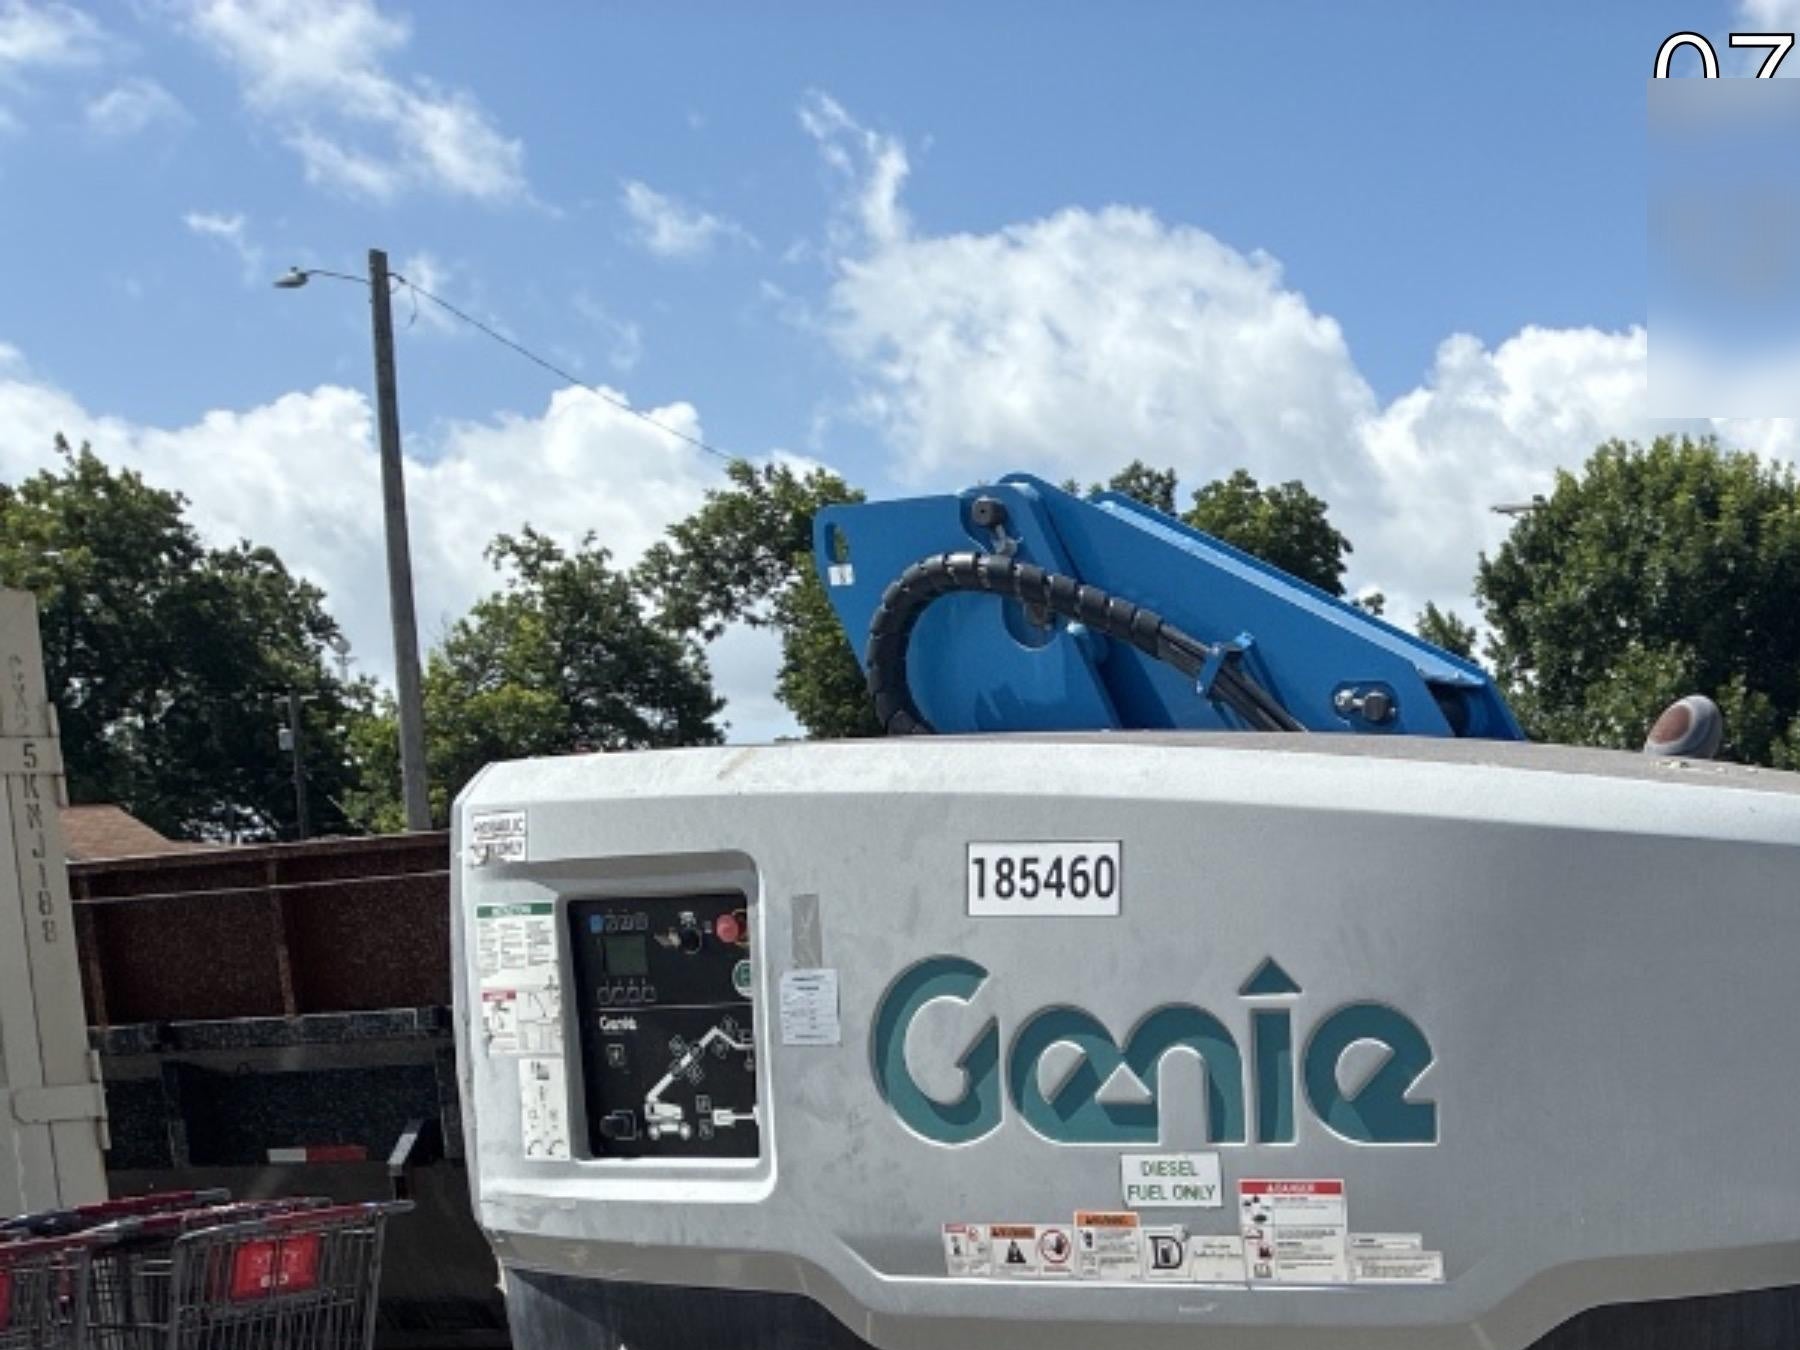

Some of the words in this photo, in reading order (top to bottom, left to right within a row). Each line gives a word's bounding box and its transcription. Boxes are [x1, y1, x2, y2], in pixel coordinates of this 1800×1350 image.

[970, 853, 1116, 902] 185460
[870, 953, 1440, 1148] Genie
[1140, 1160, 1200, 1177] DIESEL
[1127, 1184, 1168, 1201] FUEL
[1172, 1184, 1216, 1201] ONLY
